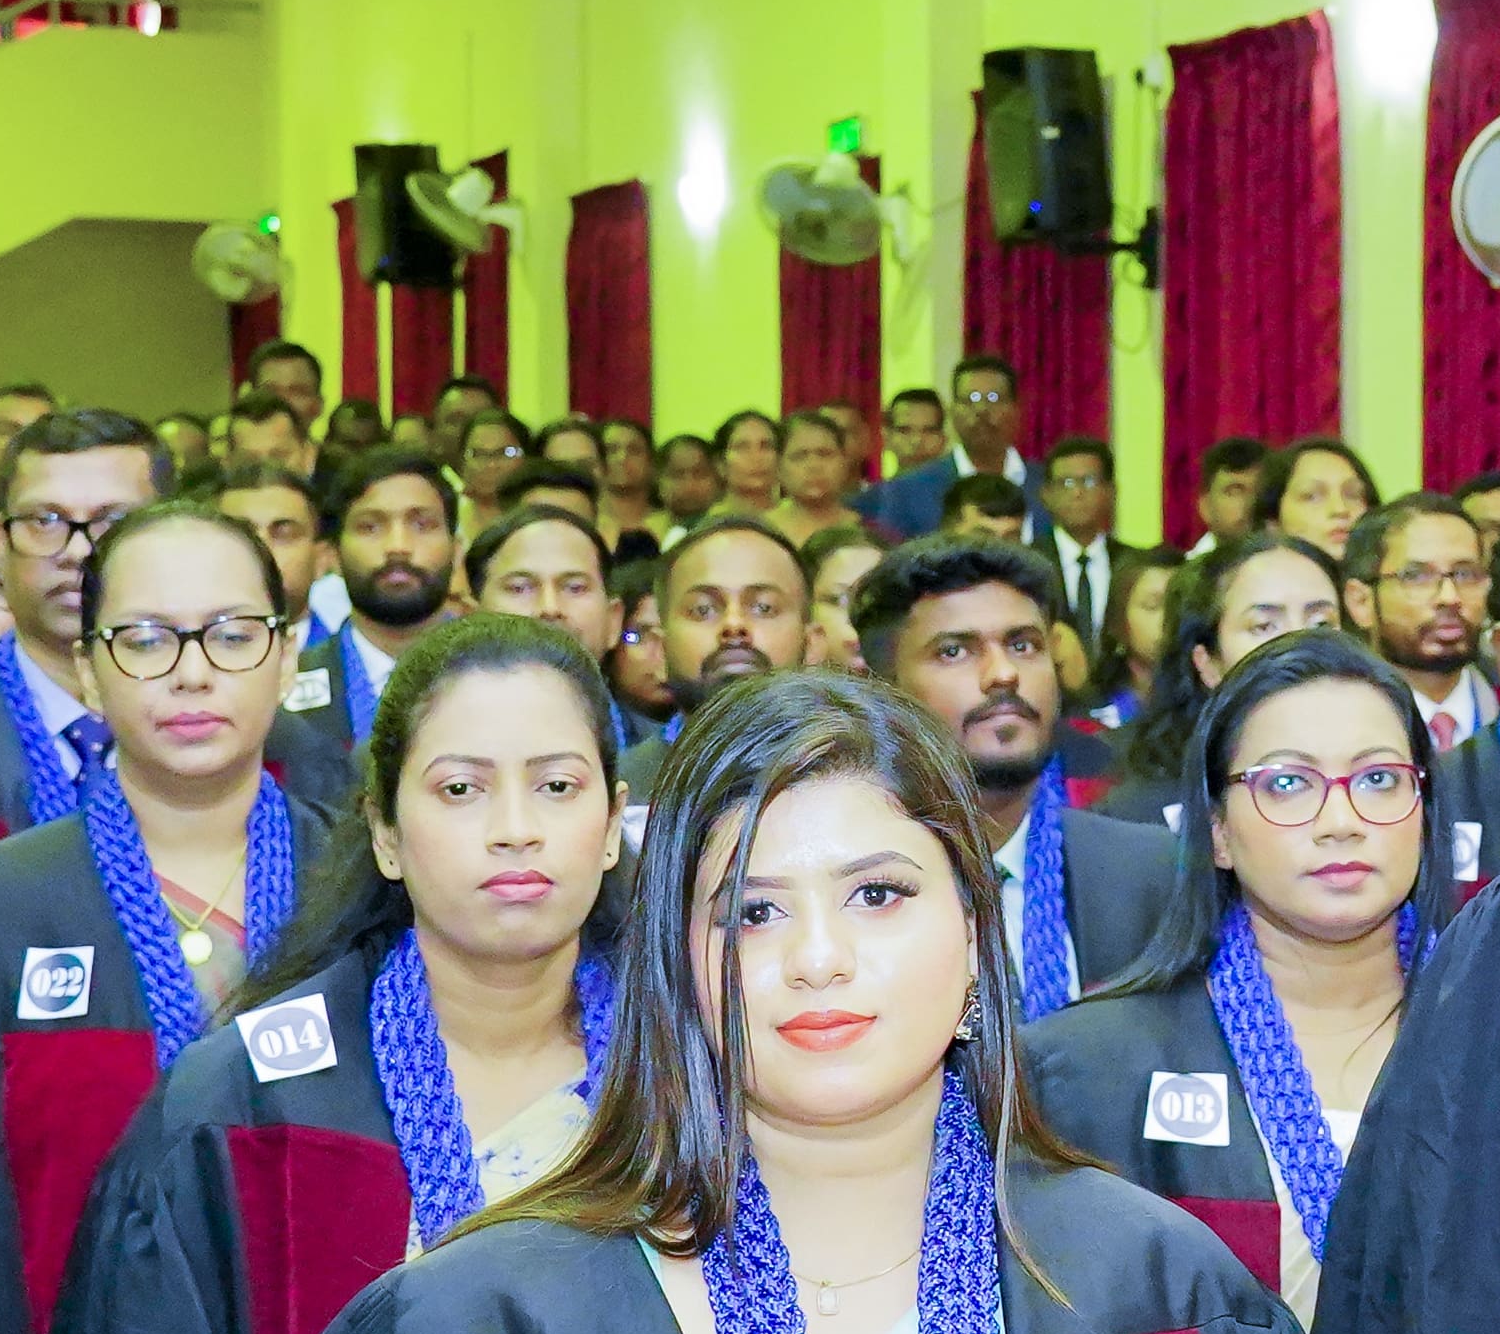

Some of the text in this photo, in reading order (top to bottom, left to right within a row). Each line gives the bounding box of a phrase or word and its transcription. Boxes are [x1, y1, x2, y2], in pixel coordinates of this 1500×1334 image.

[32, 966, 82, 998] 022
[257, 1022, 324, 1061] 014
[1163, 1090, 1217, 1123] 013
